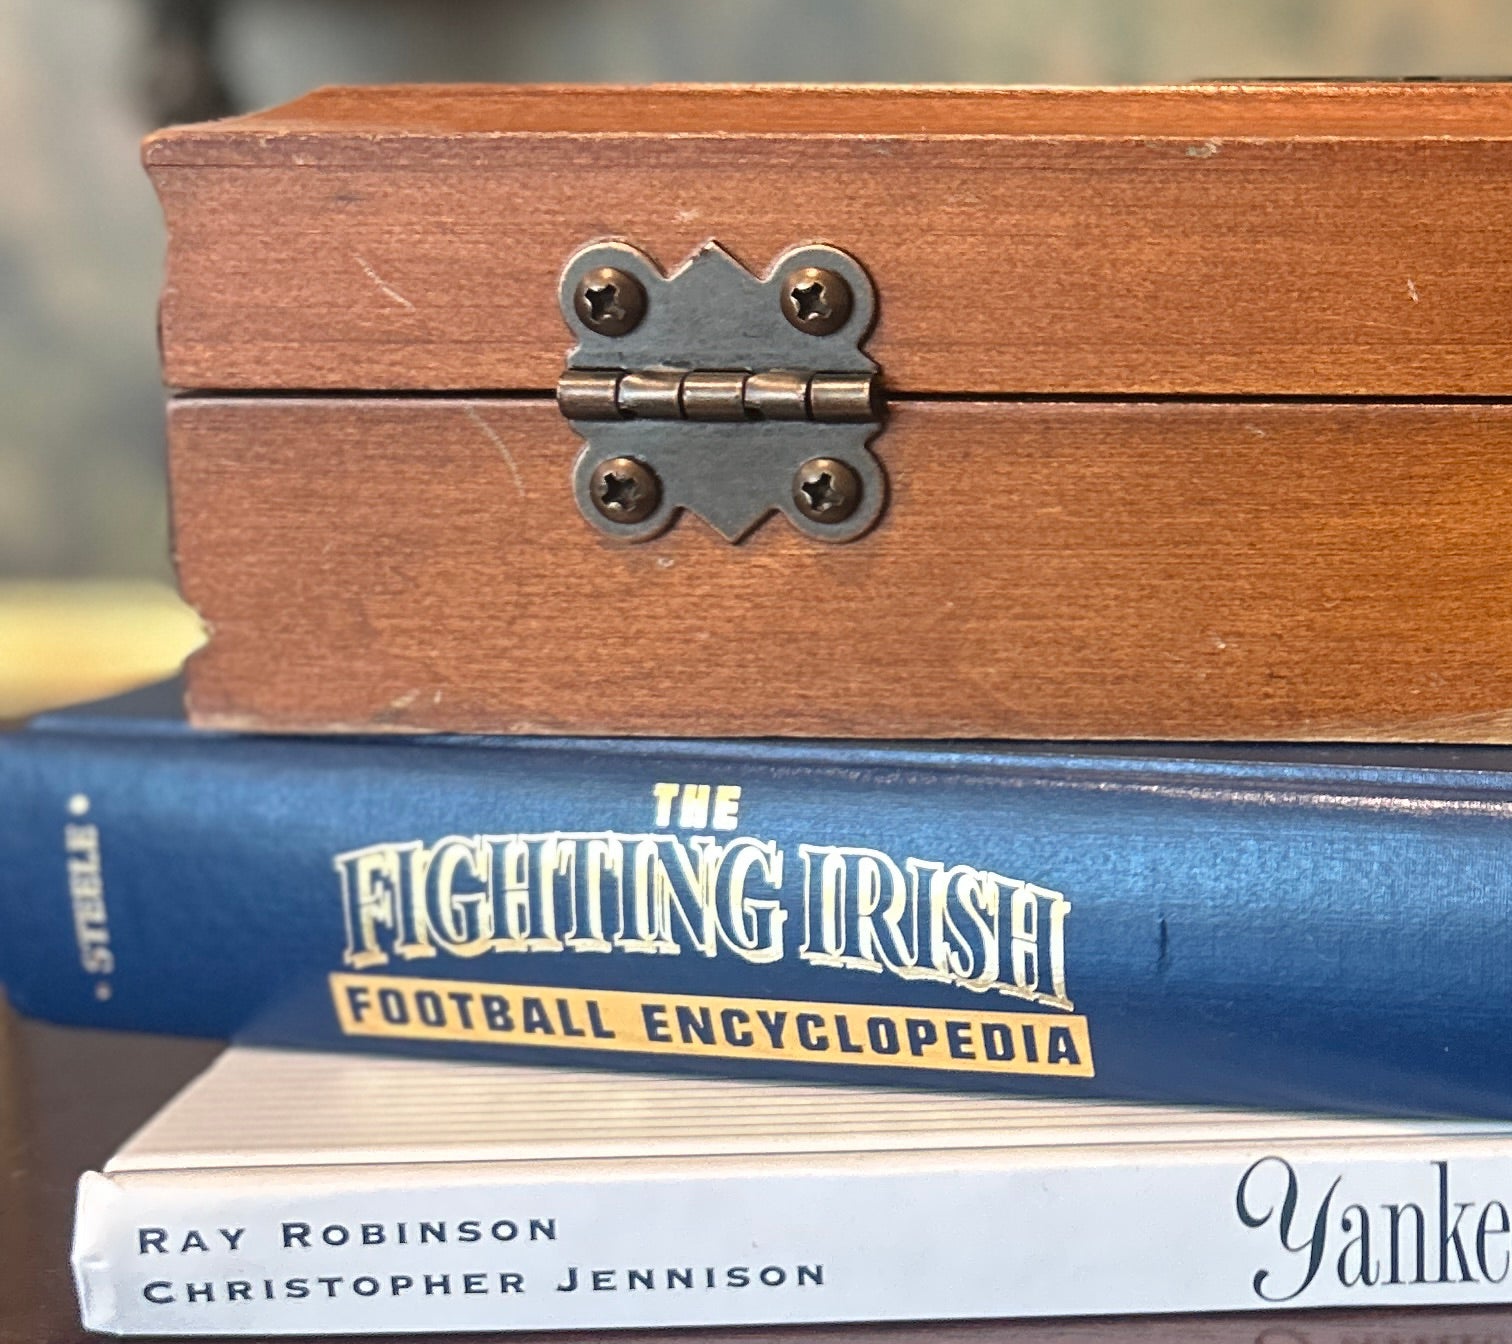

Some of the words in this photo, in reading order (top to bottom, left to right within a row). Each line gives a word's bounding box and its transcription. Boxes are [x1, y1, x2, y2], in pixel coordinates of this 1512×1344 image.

[653, 782, 742, 830] THE
[64, 822, 114, 974] STEELE
[334, 831, 787, 967] FIGHTING
[797, 844, 1076, 1011] IRISH
[345, 985, 616, 1040] FOOTBALL
[645, 1006, 1082, 1066] ENCYCLOPEDIA
[138, 1226, 247, 1255] RAY
[281, 1217, 560, 1249] ROBINSON
[142, 1271, 528, 1306] CHRISTOPHER
[556, 1263, 829, 1293] JENNISON
